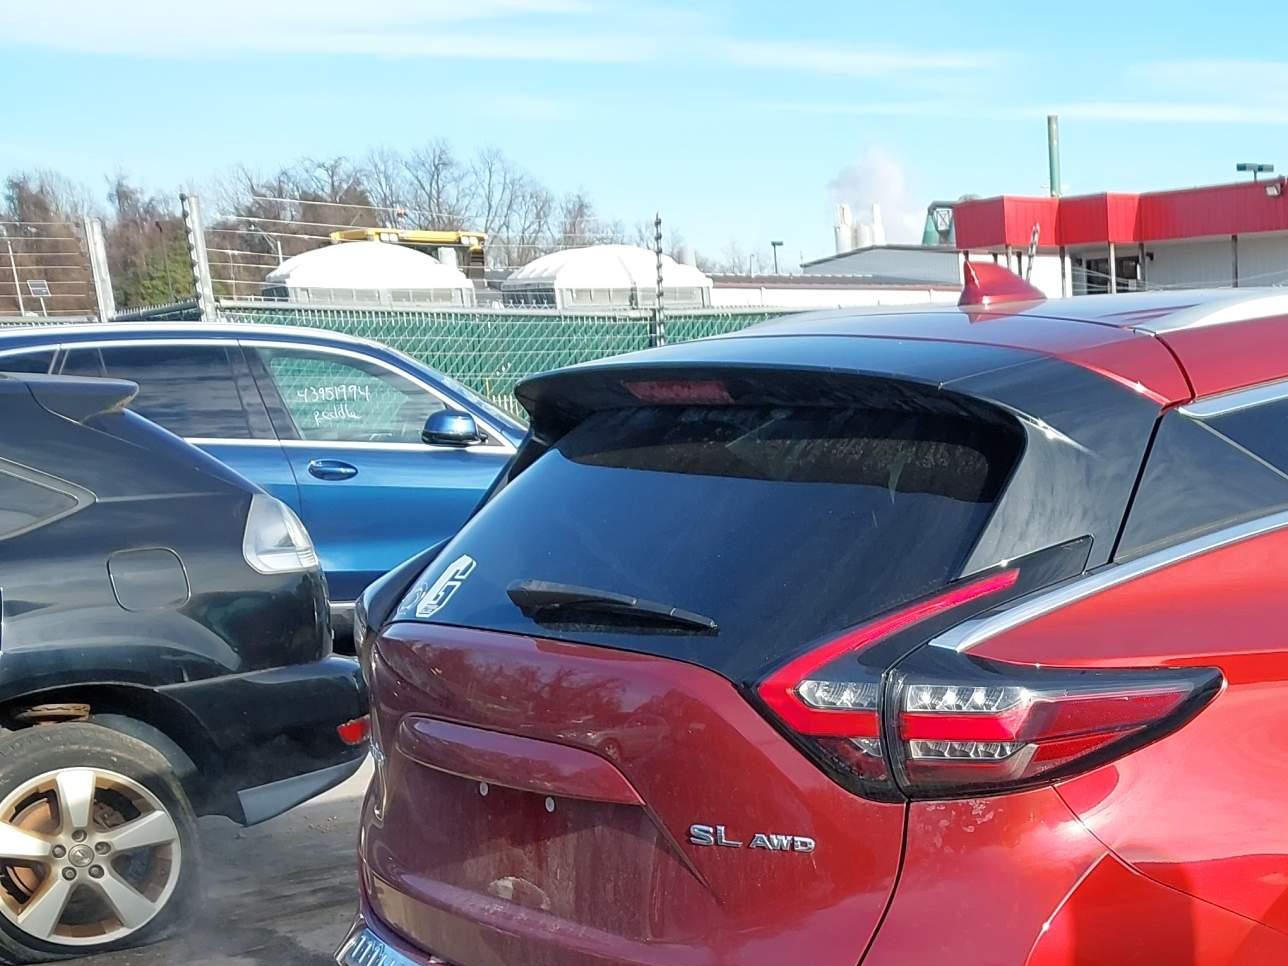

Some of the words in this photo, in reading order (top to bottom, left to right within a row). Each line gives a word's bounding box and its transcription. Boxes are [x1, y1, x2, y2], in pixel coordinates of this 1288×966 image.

[297, 385, 370, 402] 43951994
[689, 824, 743, 848] SL
[749, 834, 817, 853] AWD
